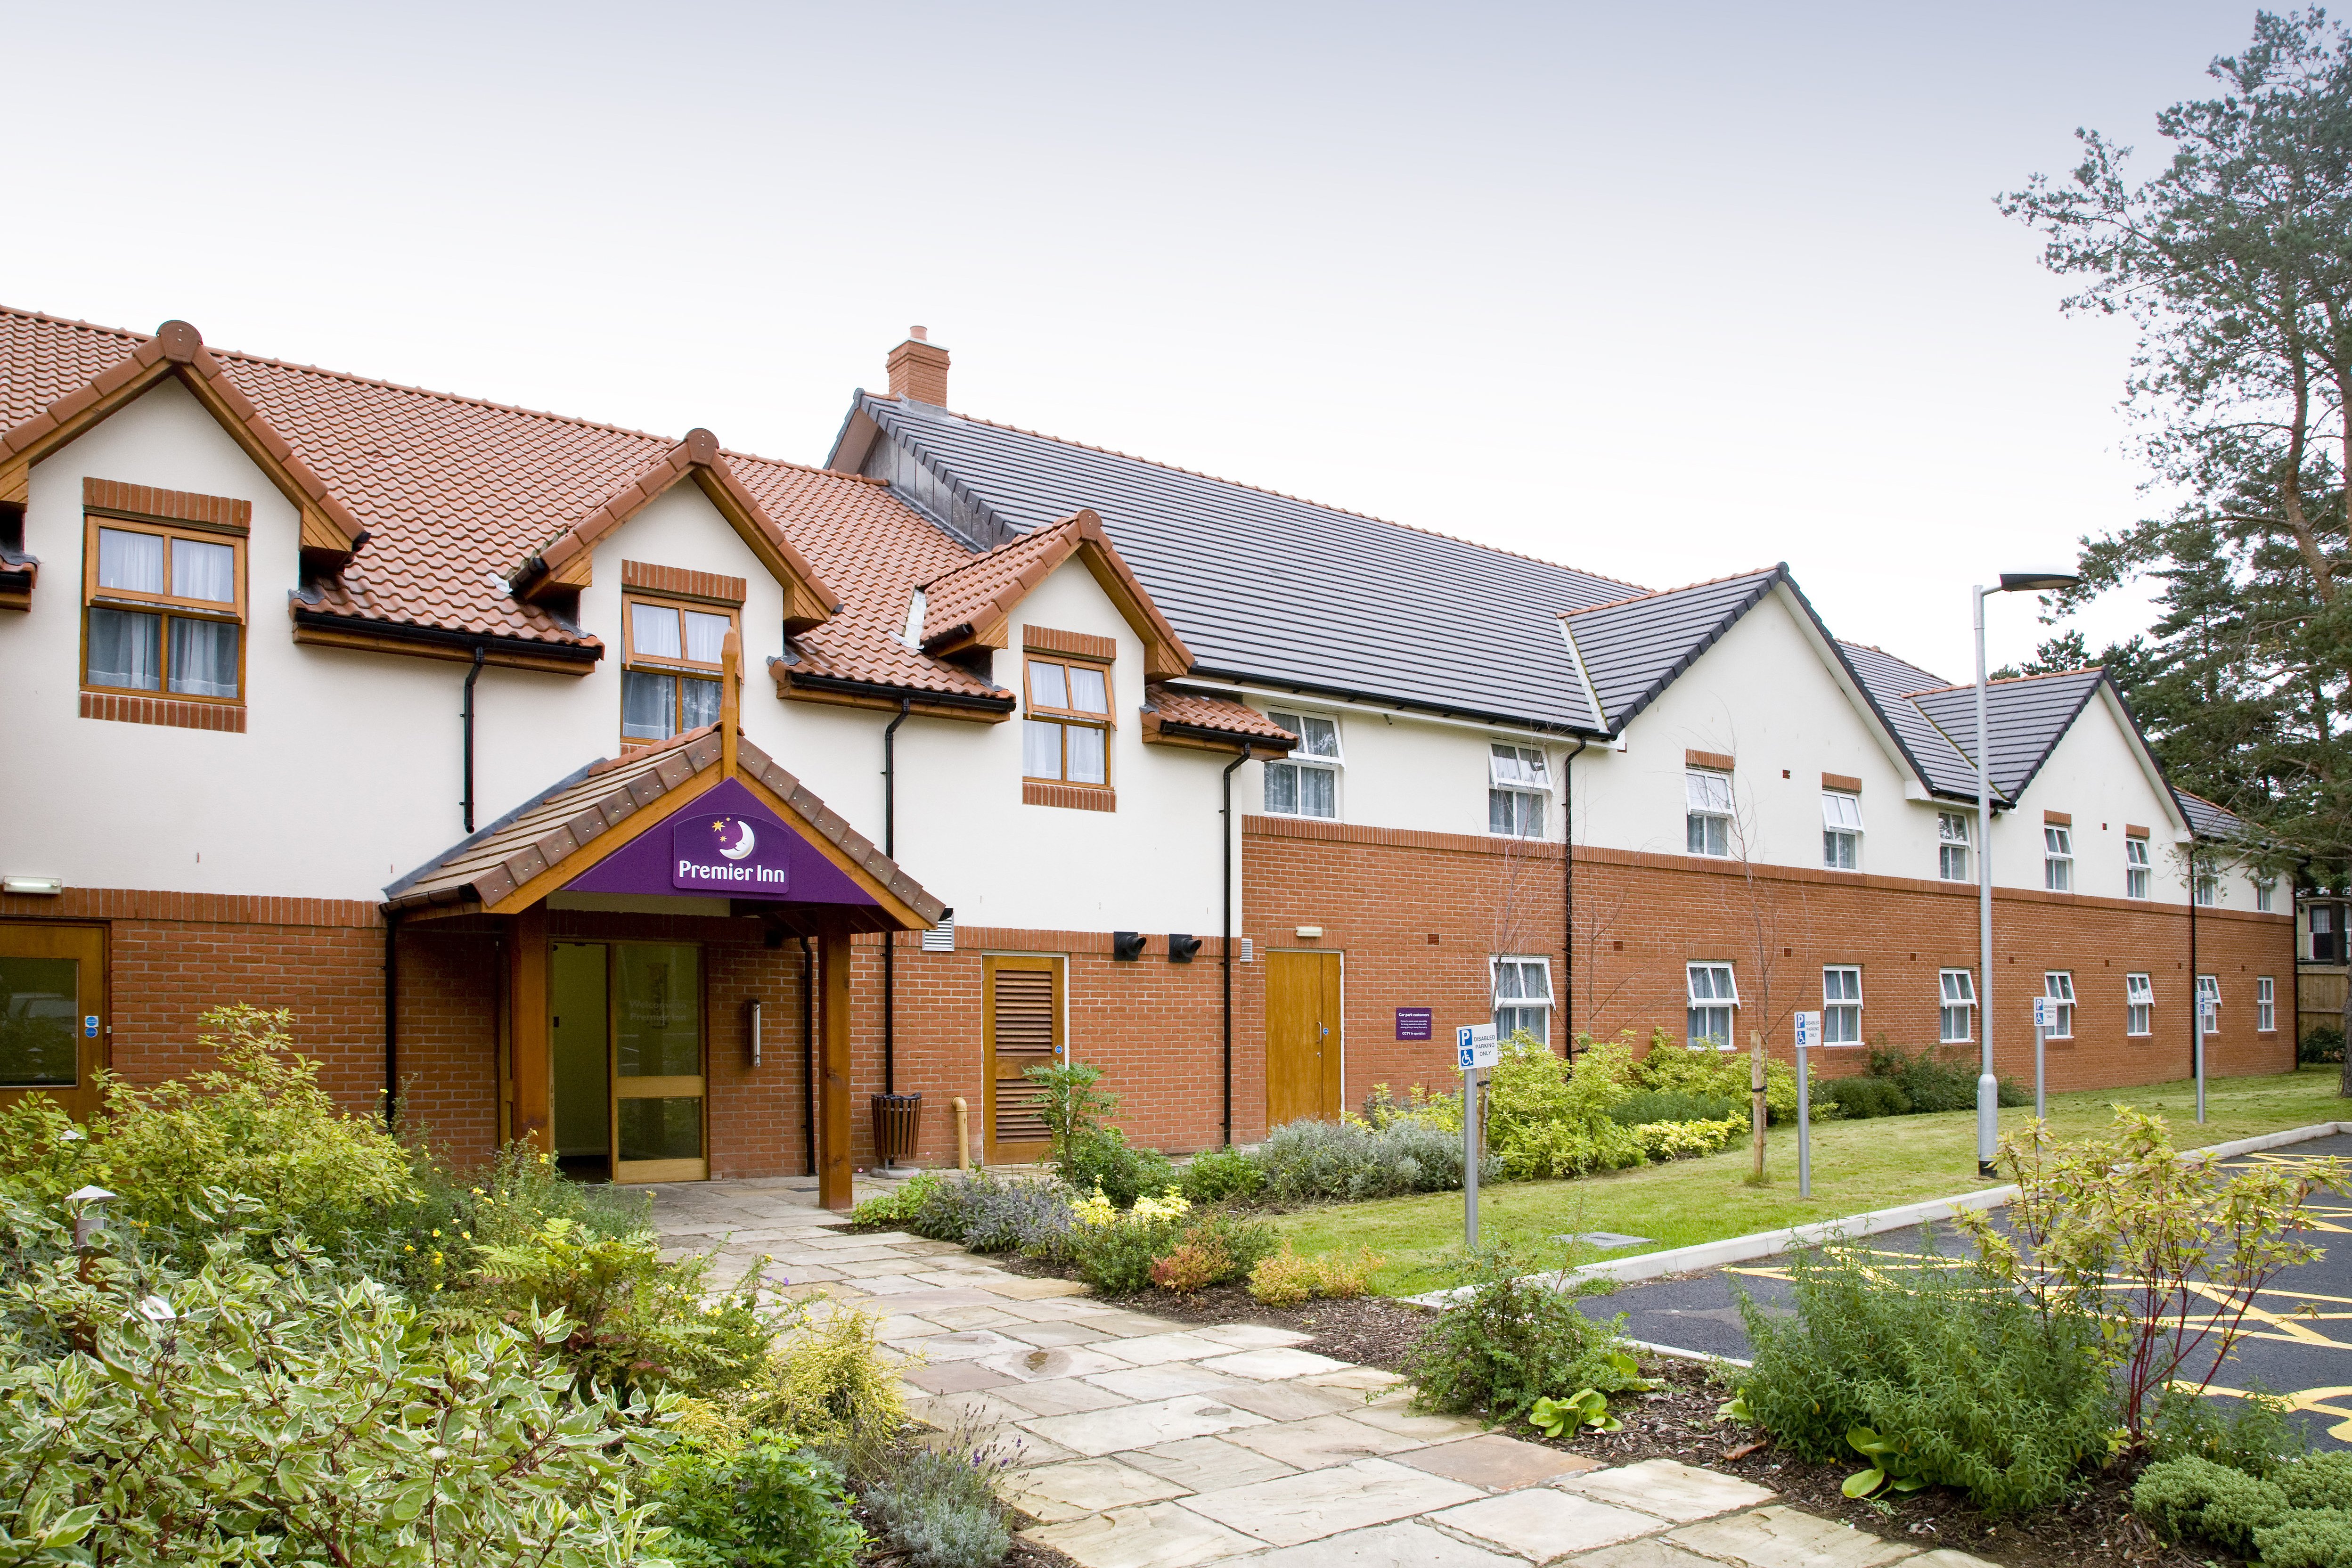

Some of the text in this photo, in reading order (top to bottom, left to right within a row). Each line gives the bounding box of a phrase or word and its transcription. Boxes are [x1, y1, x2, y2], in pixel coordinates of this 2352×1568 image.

[679, 860, 784, 882] Premier Inn
[2036, 1000, 2042, 1010] P
[630, 1013, 669, 1021] Premier
[1797, 1015, 1804, 1028] P
[1461, 1030, 1470, 1045] P
